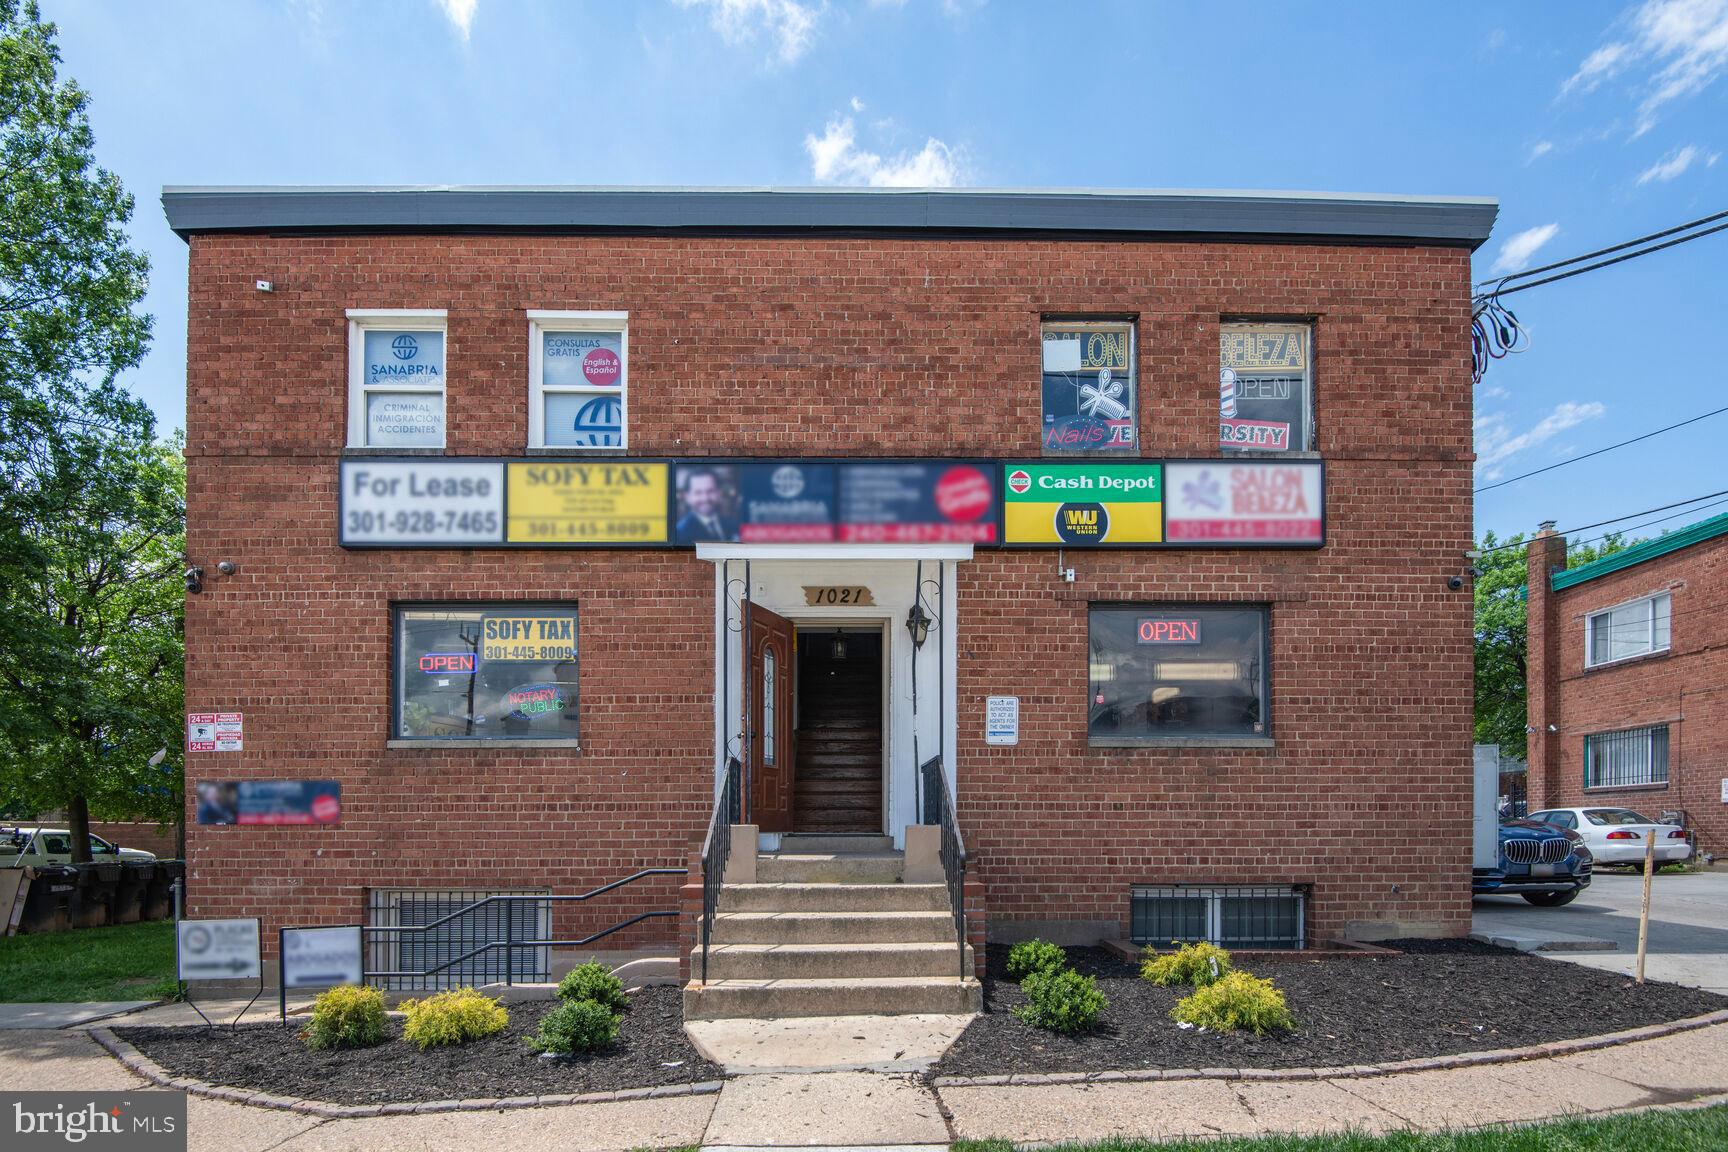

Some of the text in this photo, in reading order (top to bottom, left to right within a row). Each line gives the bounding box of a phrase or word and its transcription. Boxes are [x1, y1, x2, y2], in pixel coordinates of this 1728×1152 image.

[547, 339, 601, 348] CONSULTAS
[547, 348, 581, 357] GRATIS
[371, 364, 438, 376] SANABRIA
[583, 358, 619, 367] English &
[585, 366, 617, 375] Español
[372, 375, 380, 384] &
[383, 403, 431, 412] CRIMINAL
[377, 425, 436, 434] ACCIDENTES
[1046, 425, 1105, 446] Nails
[526, 465, 651, 486] SOFY TAX
[354, 471, 491, 498] For Lease
[1038, 475, 1156, 492] Cash Depot
[348, 510, 498, 535] 301-928-7465
[1064, 510, 1098, 525] WU
[815, 588, 862, 604] 1021
[485, 619, 573, 640] SOFY TAX
[1140, 621, 1198, 641] OPEN
[485, 646, 572, 659] 301-445-8009
[419, 655, 474, 671] OPEN
[508, 688, 557, 704] NOTARY
[520, 699, 565, 714] PUBLIC
[191, 715, 201, 723] 24
[191, 742, 201, 750] 24
